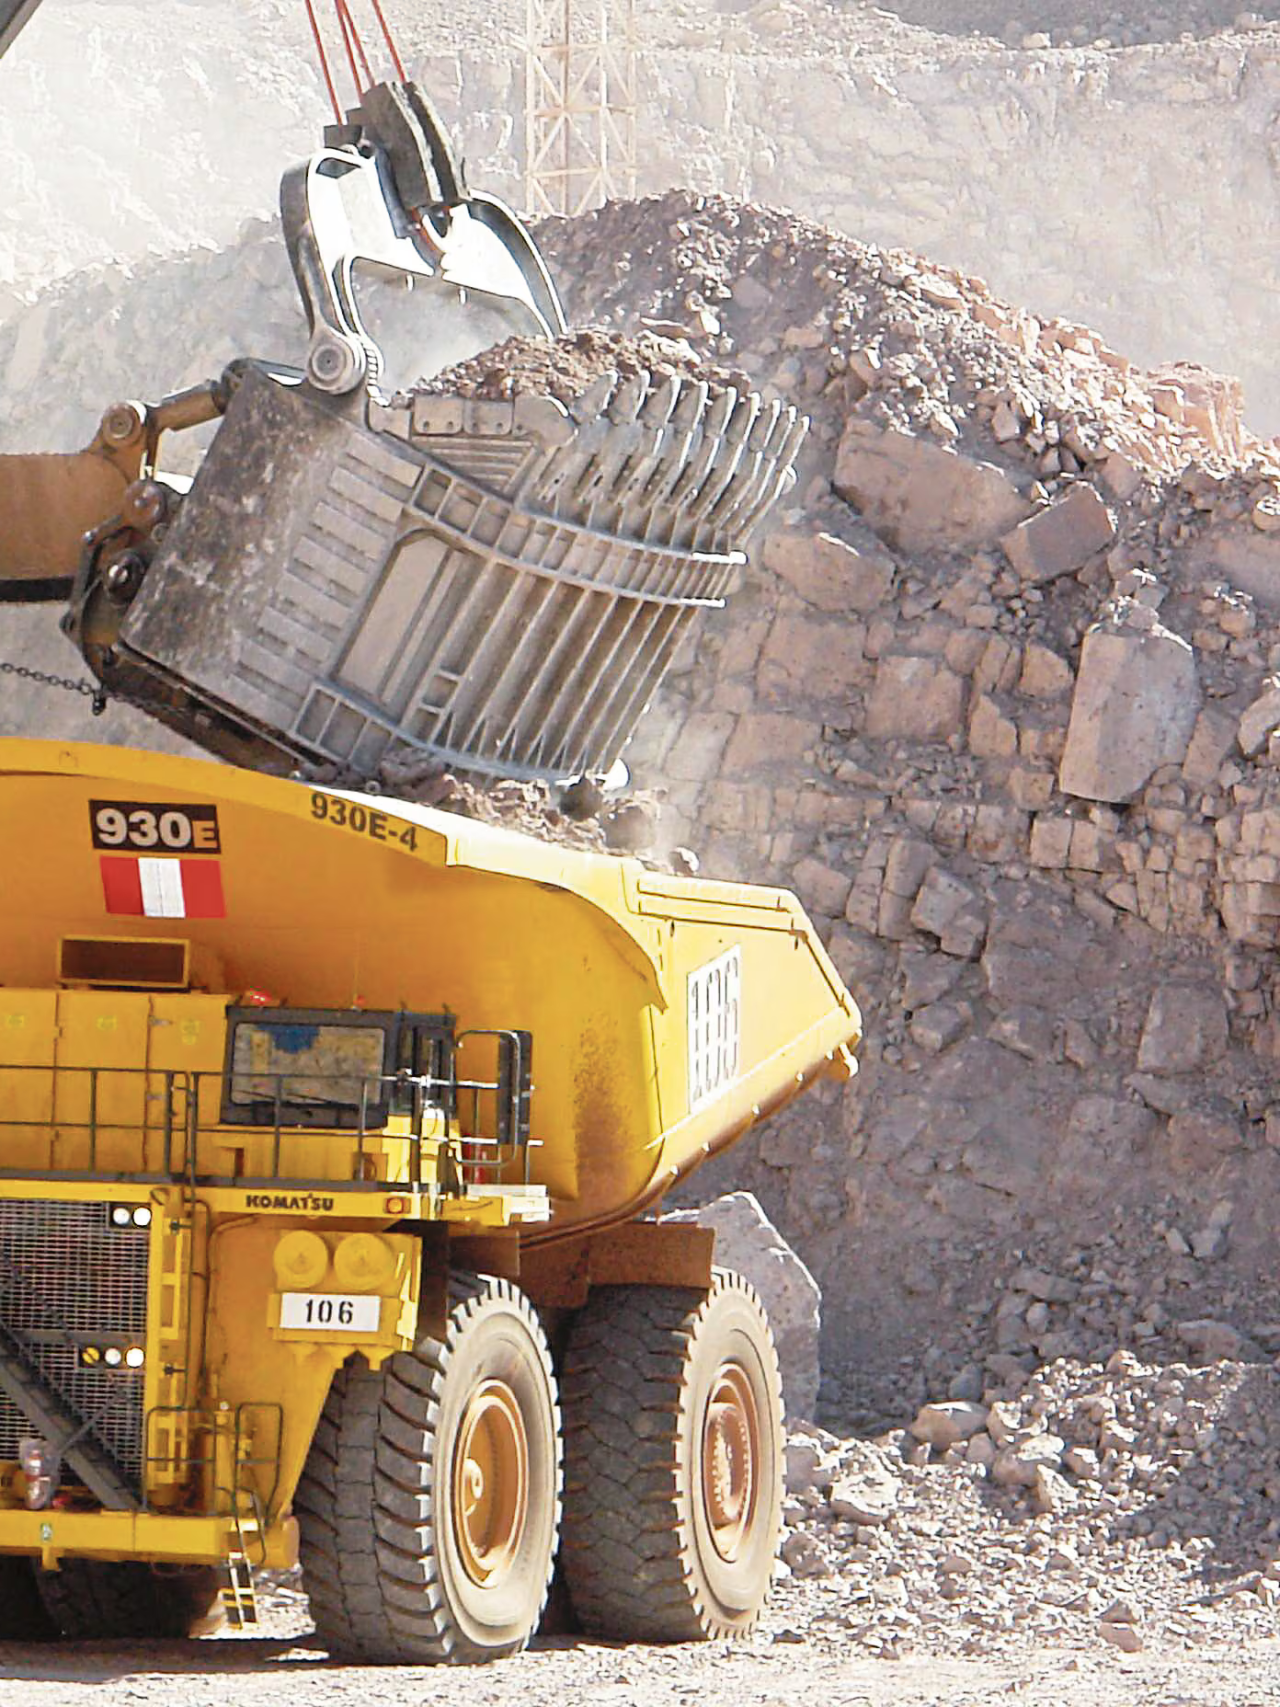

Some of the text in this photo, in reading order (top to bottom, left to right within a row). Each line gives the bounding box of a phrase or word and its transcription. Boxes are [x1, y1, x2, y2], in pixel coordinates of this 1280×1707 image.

[96, 807, 218, 849] 930E
[310, 792, 418, 852] 930E-4
[245, 1193, 334, 1211] KOMATSU
[305, 1299, 353, 1324] 106
